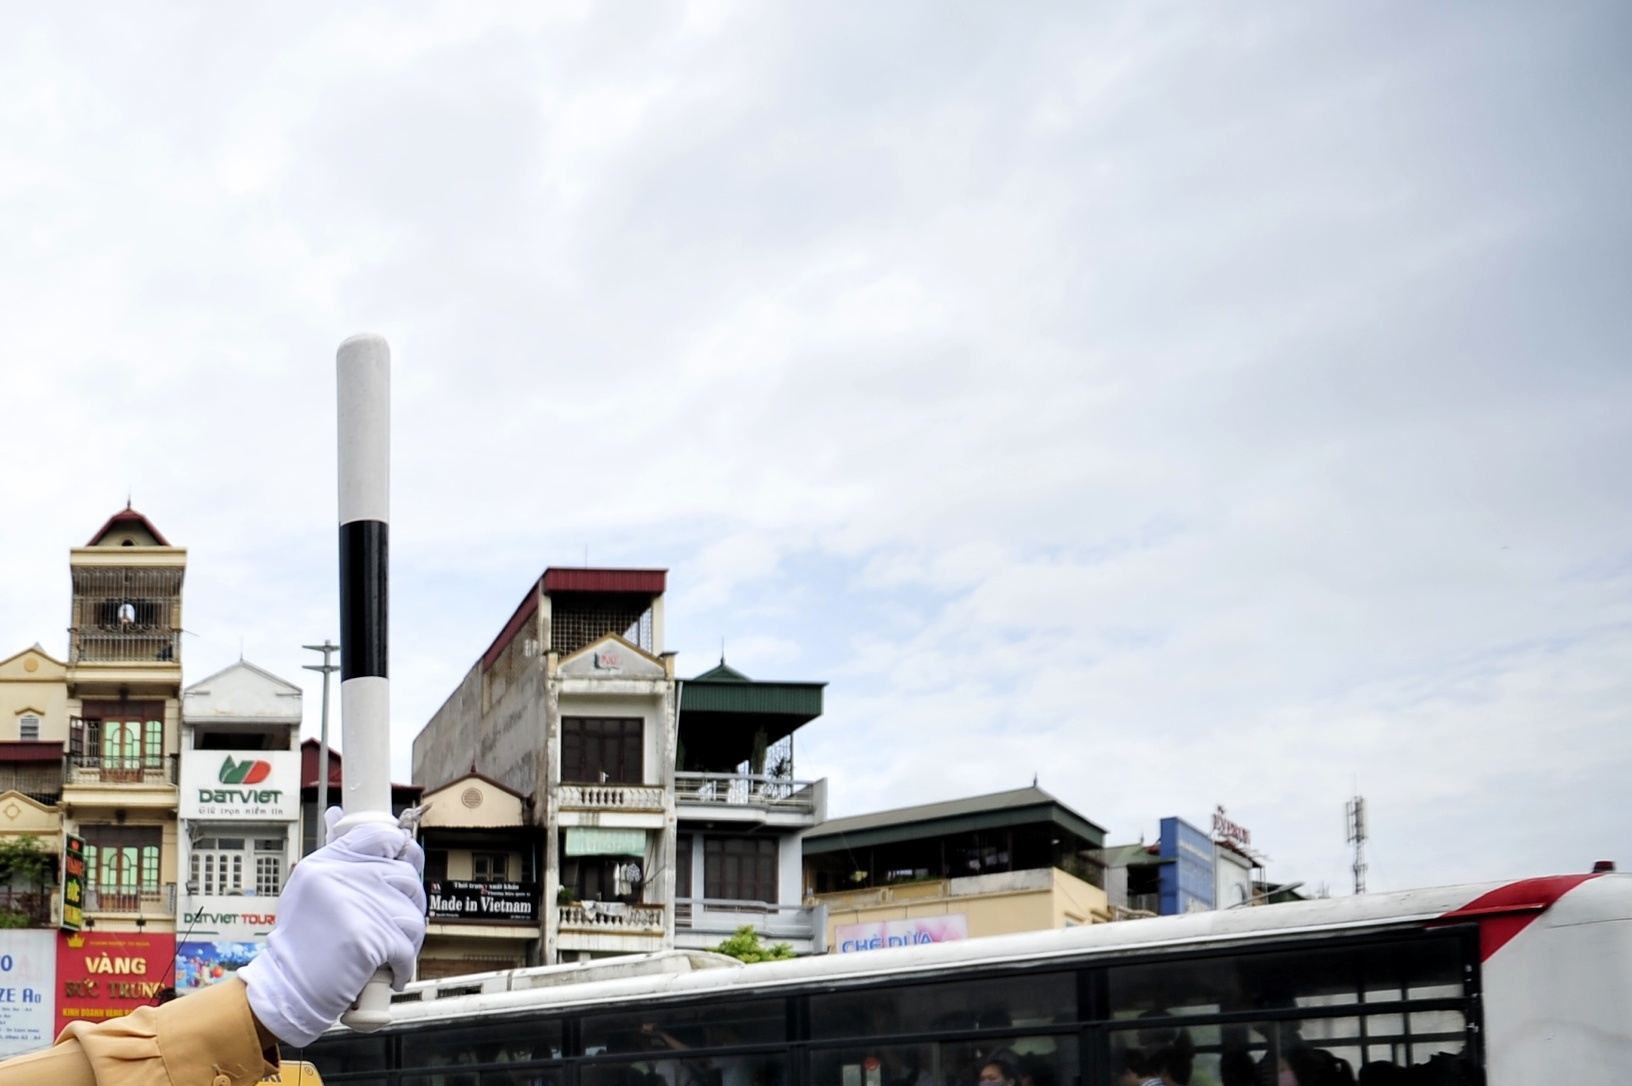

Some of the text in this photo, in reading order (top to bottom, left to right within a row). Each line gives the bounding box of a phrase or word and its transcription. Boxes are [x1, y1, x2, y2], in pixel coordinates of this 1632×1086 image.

[430, 895, 531, 913] Made in Vietnam
[85, 951, 147, 974] VÀNG
